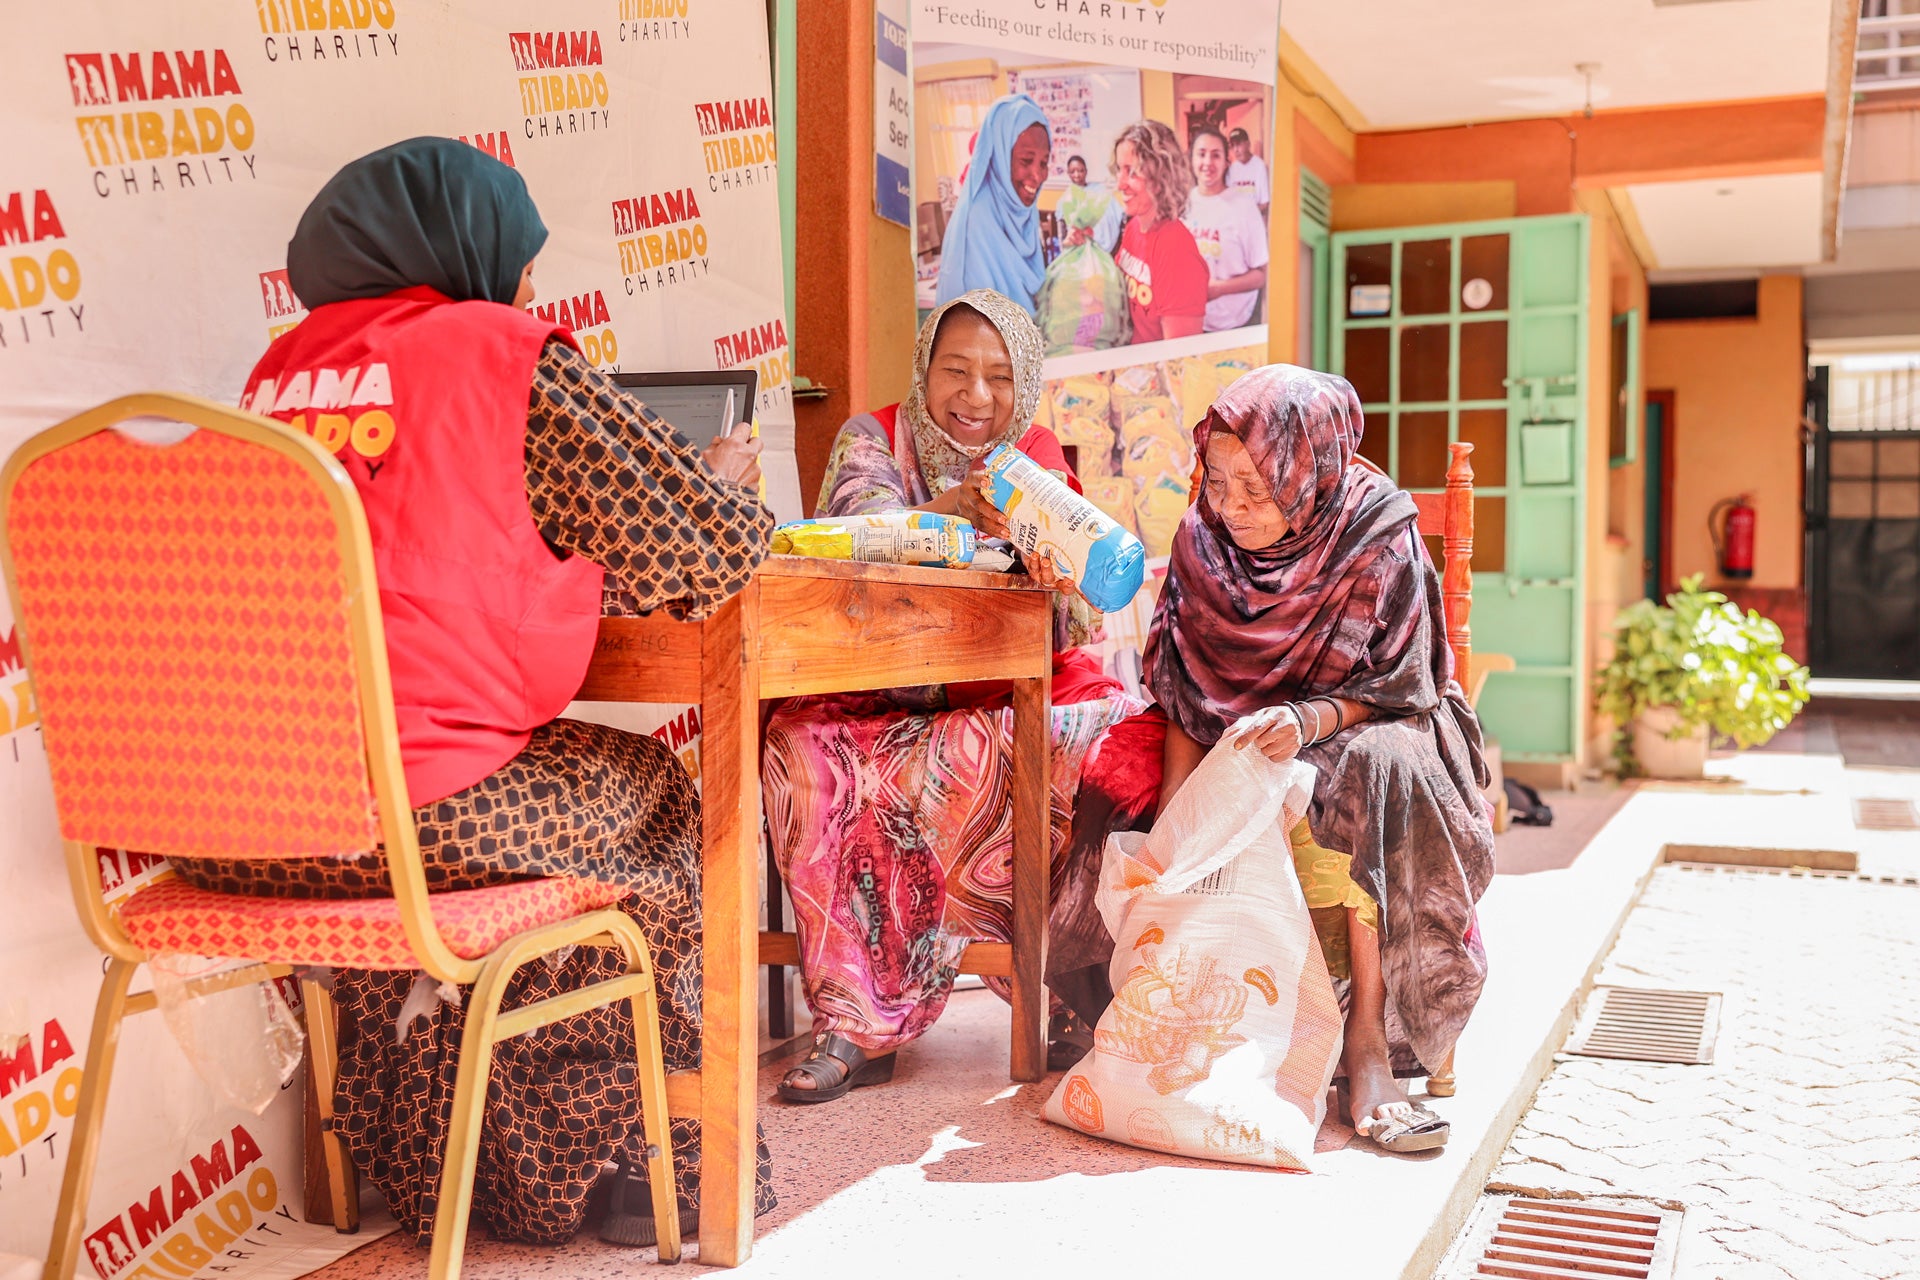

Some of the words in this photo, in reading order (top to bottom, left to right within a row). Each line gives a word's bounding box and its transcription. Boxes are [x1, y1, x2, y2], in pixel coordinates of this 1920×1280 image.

[619, 21, 690, 42] CHARITY
[1034, 0, 1165, 25] CHARITY
[265, 33, 398, 62] CHARITY
[534, 30, 603, 69] MAMA
[1013, 21, 1042, 38] our
[1047, 22, 1097, 44] elders
[1102, 28, 1114, 47] is
[1119, 35, 1149, 52] our
[110, 49, 243, 103] MAMA
[541, 71, 609, 113] IBADO
[715, 97, 772, 133] MAMA
[889, 87, 909, 118] Acc
[121, 103, 255, 162] IBADO
[525, 109, 610, 139] CHARITY
[889, 121, 909, 150] Ser
[722, 131, 777, 169] IBADO
[94, 154, 256, 198] CHARITY
[709, 164, 778, 192] CHARIT
[0, 189, 67, 246] MA
[632, 187, 702, 231] MAMA
[637, 223, 708, 270] IBADO
[624, 257, 709, 296] CHARITY
[732, 319, 788, 364] MAMA
[250, 362, 394, 416] MAMA
[1025, 522, 1039, 556] SAFIN
[668, 706, 702, 752] MA
[0, 1018, 75, 1099] MA
[128, 1124, 263, 1250] MAMA
[149, 1166, 279, 1278] IBADO
[193, 1204, 298, 1280] ARITY
